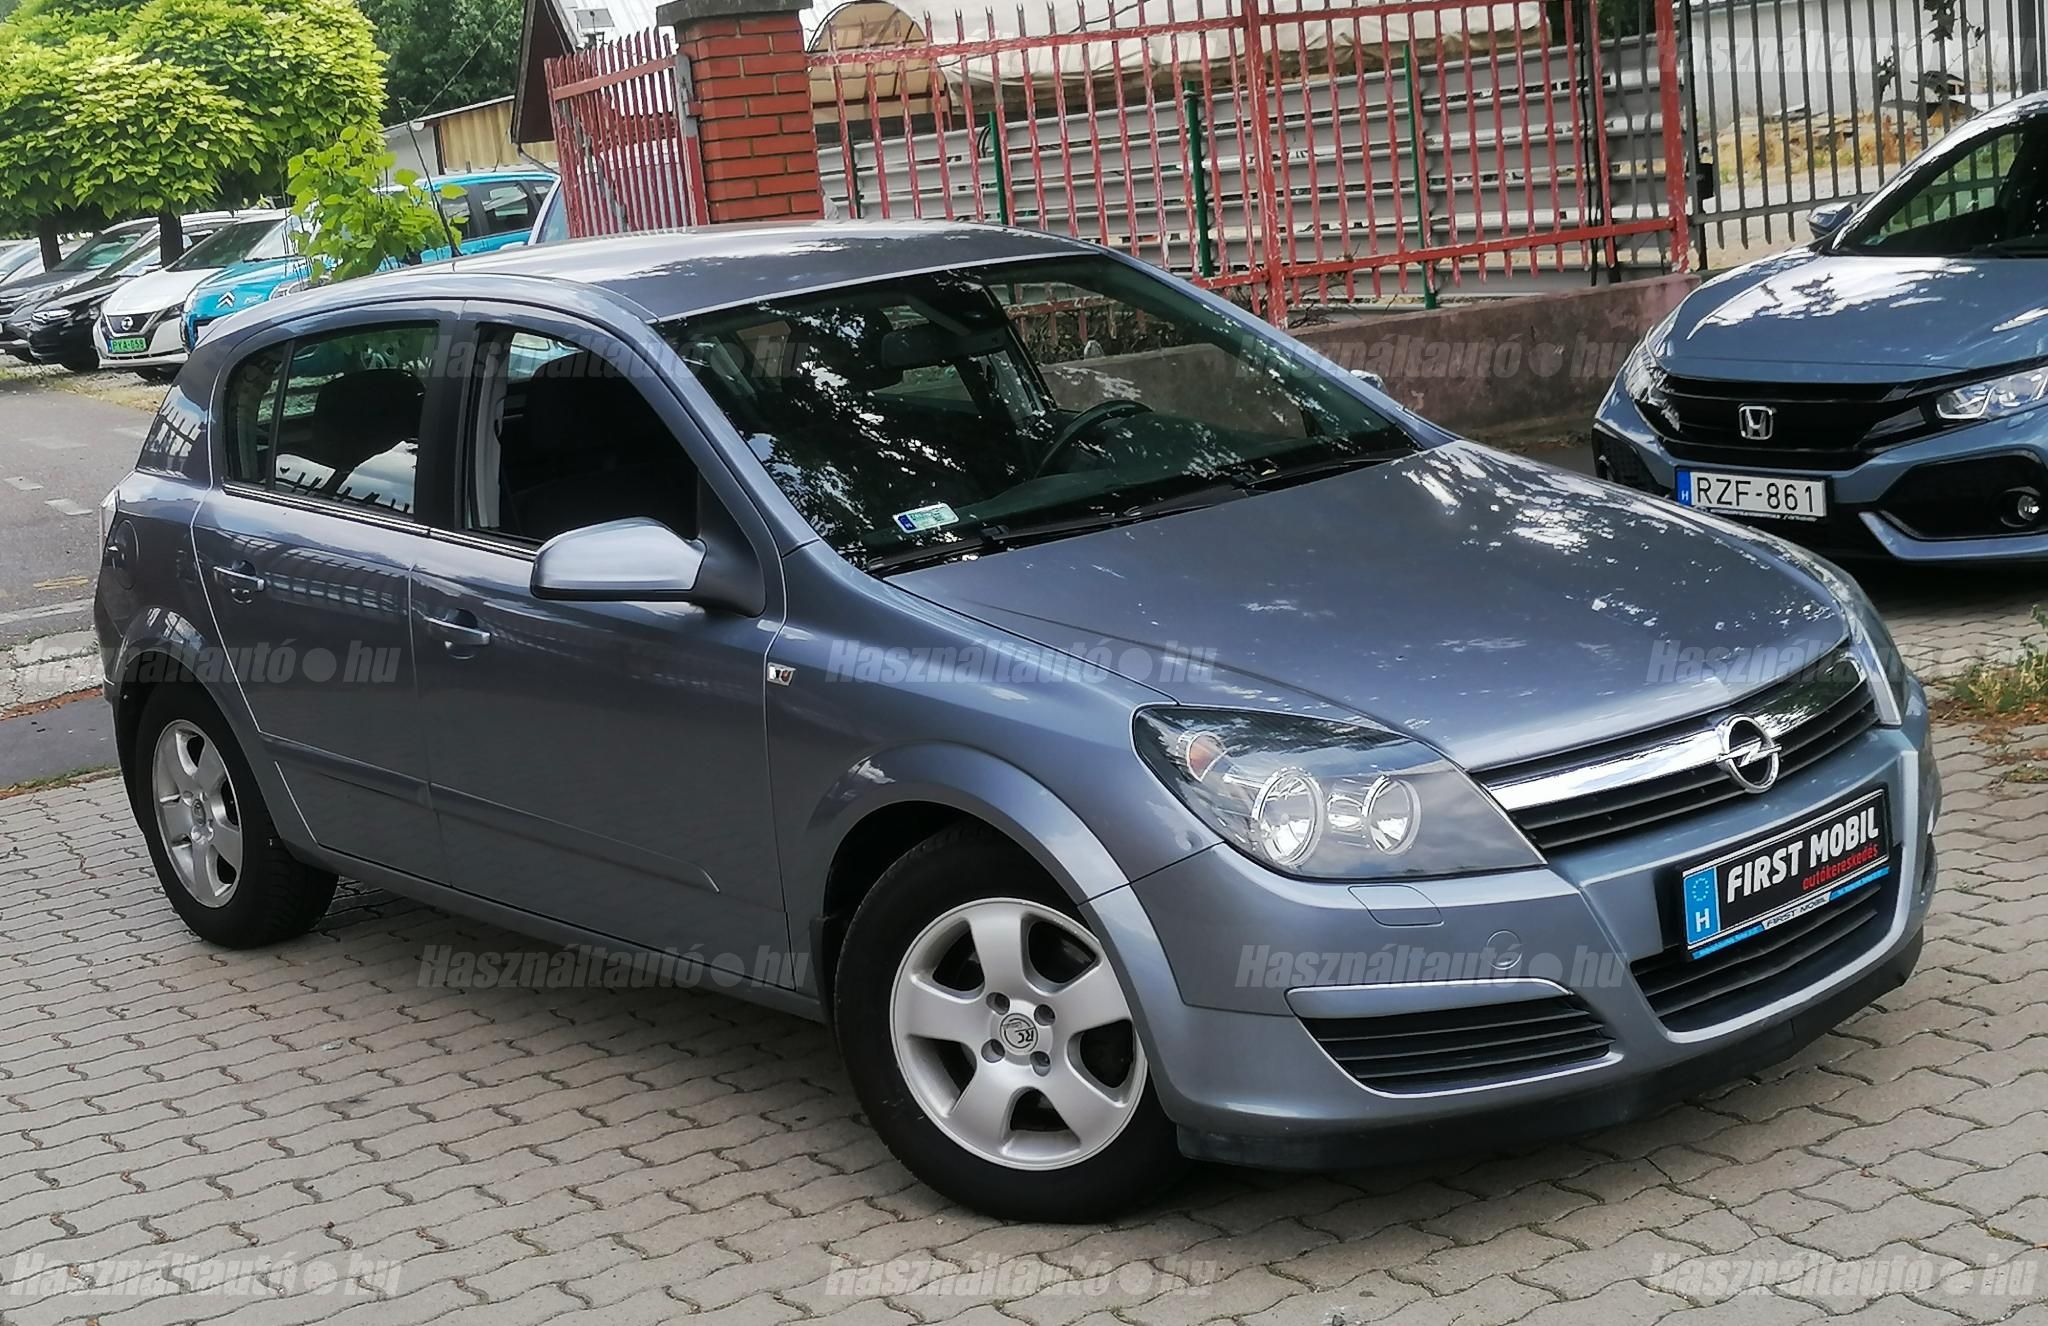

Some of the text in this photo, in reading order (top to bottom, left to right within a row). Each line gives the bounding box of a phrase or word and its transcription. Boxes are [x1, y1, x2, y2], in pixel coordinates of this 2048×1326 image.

[1696, 477, 1814, 513] RZF-861
[1727, 840, 1803, 903] FIRST
[1809, 807, 1879, 868] MOBIL
[1802, 843, 1879, 890] autókereskedés
[1695, 908, 1710, 932] H
[1766, 910, 1799, 927] FIRST
